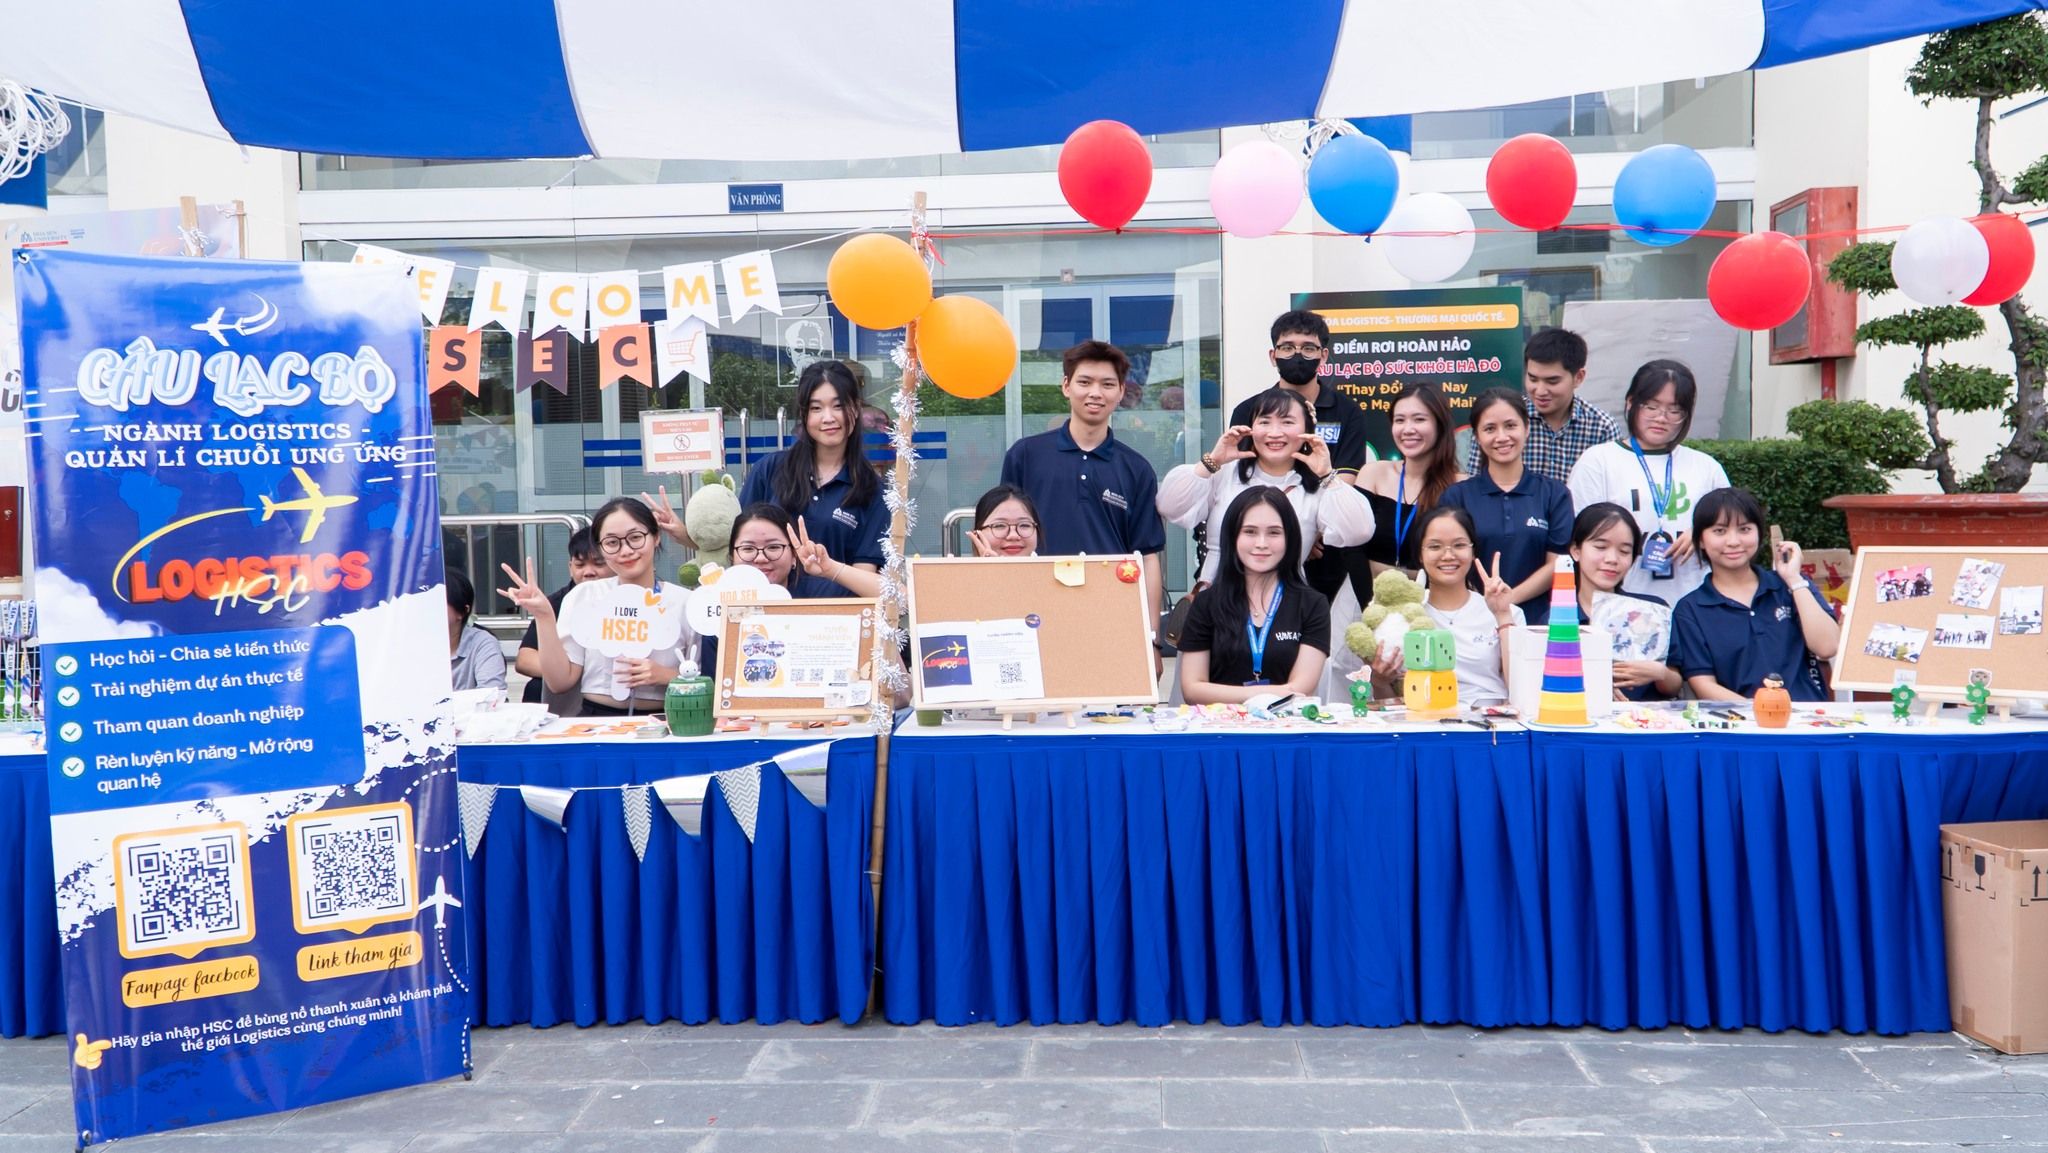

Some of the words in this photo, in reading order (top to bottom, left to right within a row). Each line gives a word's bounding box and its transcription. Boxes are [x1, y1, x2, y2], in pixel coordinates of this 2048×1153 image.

[731, 192, 750, 206] VĂN
[751, 192, 780, 206] PHÒNG
[356, 255, 762, 317] ELCOME
[1333, 338, 1368, 354] ĐIỂM
[1371, 340, 1395, 354] RƠI
[1398, 338, 1438, 353] HOÀN
[1440, 336, 1471, 352] HẢO
[77, 336, 202, 412] CÂU
[204, 350, 312, 417] LẠC
[310, 346, 396, 413] BỘ
[1335, 362, 1362, 380] LẠC
[1362, 360, 1384, 378] BỘ
[1386, 358, 1414, 376] SỨC
[1416, 357, 1456, 374] KHỎE
[1456, 358, 1476, 373] HÀ
[1478, 357, 1501, 372] ĐÔ
[1442, 382, 1468, 394] Nay
[104, 420, 202, 442] NGÀNH
[212, 423, 352, 441] LOGISTICS
[65, 446, 146, 469] QUẢN
[158, 446, 186, 466] LÍ
[196, 443, 280, 466] CHUỖI
[290, 448, 346, 464] UNG
[355, 442, 406, 462] ỨNG
[129, 551, 372, 604] LOGISTICS
[209, 574, 310, 616] HSC
[614, 606, 618, 616] I
[620, 607, 638, 617] LOVE
[707, 606, 722, 618] E-C
[602, 618, 648, 642] HSEC
[90, 652, 125, 668] Học
[128, 649, 155, 664] hỏi
[171, 646, 210, 662] Chia
[236, 640, 269, 656] kiến
[272, 639, 310, 654] thức
[92, 682, 126, 698] Trải
[129, 678, 192, 698] nghiệm
[195, 675, 218, 692] dự
[222, 674, 242, 686] án
[246, 670, 284, 687] thực
[286, 666, 304, 682] tế
[93, 720, 142, 734] Tham
[146, 717, 188, 734] quan
[192, 709, 245, 727] doanh
[249, 704, 304, 724] nghiệp
[96, 755, 128, 770] Rèn
[132, 751, 174, 767] luyện
[177, 748, 195, 764] kỹ
[198, 745, 237, 760] năng
[250, 738, 276, 754] Mở
[278, 738, 313, 754] rộng
[97, 778, 138, 794] quan
[141, 773, 161, 788] hệ
[308, 950, 340, 972] Link
[346, 946, 385, 966] tham
[389, 942, 413, 971] gia
[125, 976, 190, 1001] Fanpage
[194, 964, 256, 993] facebook
[112, 1036, 138, 1048] Hãy
[142, 1032, 162, 1046] gia
[166, 1026, 200, 1040] nhập
[202, 1020, 233, 1034] HSC
[236, 1014, 252, 1029] để
[254, 1012, 288, 1026] bùng
[290, 1005, 307, 1020] nổ
[310, 1001, 348, 1017] thanh
[350, 997, 380, 1010] xuân
[383, 994, 397, 1004] và
[400, 990, 432, 1002] khám
[433, 983, 452, 998] phá
[181, 1038, 204, 1052] thế
[206, 1034, 230, 1050] giới
[234, 1027, 290, 1045] Logistics
[293, 1020, 326, 1034] cùng
[328, 1016, 367, 1028] chúng
